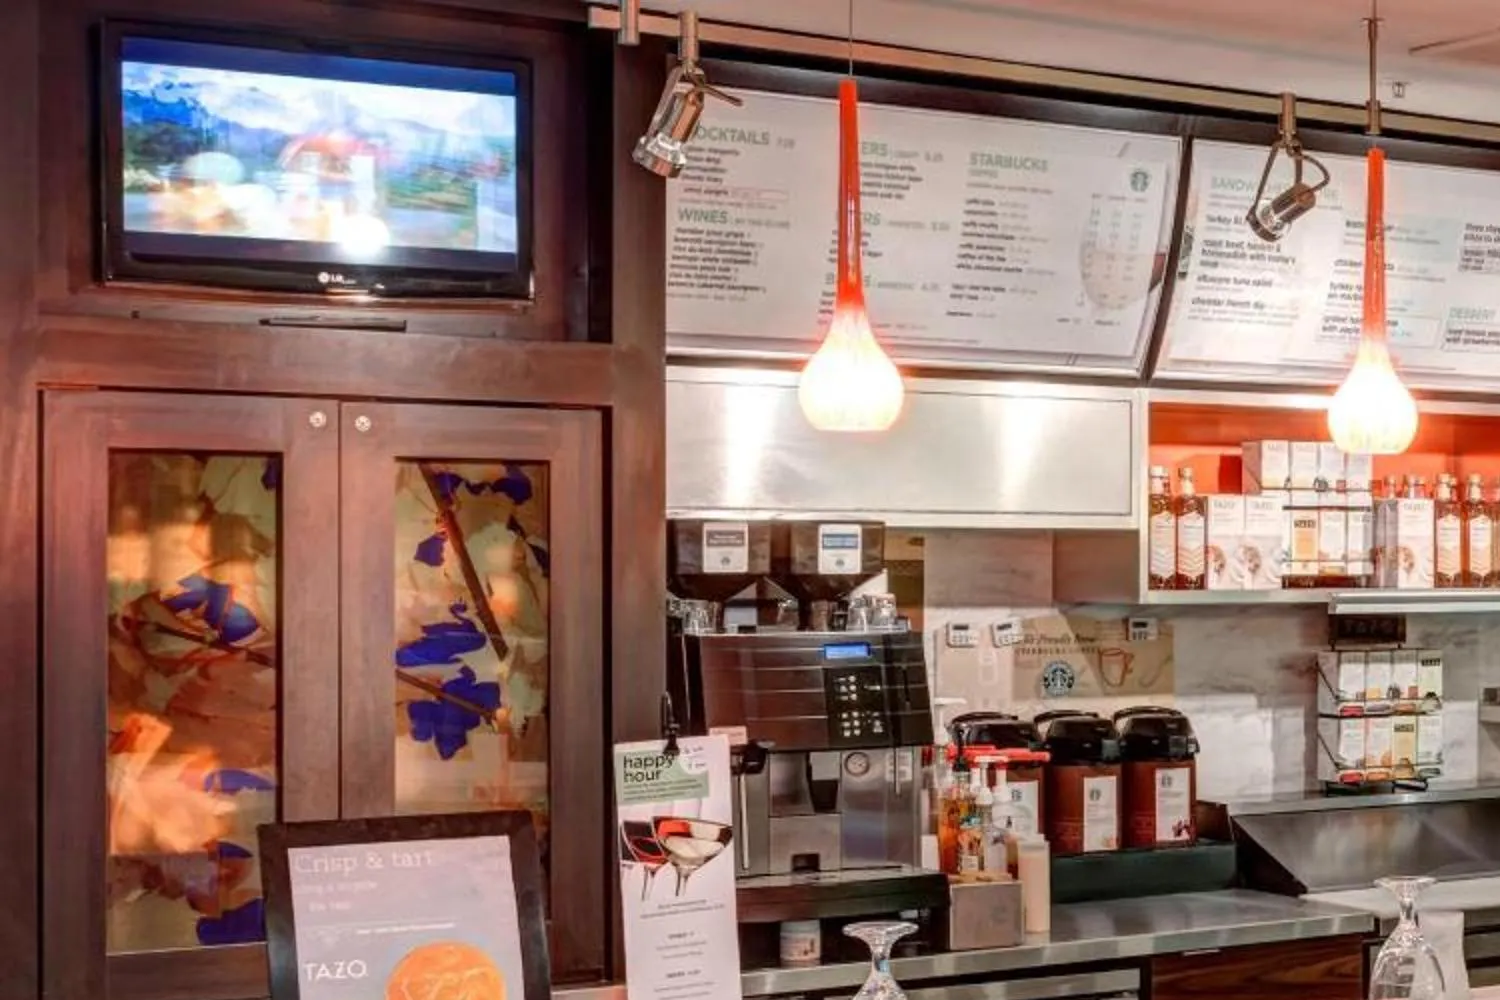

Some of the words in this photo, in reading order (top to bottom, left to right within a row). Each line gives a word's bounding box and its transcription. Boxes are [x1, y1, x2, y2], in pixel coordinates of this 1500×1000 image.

[690, 125, 770, 146] OCKTAILS
[969, 152, 1049, 173] STARBUCKS
[678, 208, 729, 225] WINES
[623, 753, 676, 769] happy
[623, 769, 662, 783] hour
[294, 852, 358, 877] Crisp
[365, 852, 384, 869] &
[303, 959, 368, 981] TAZO
